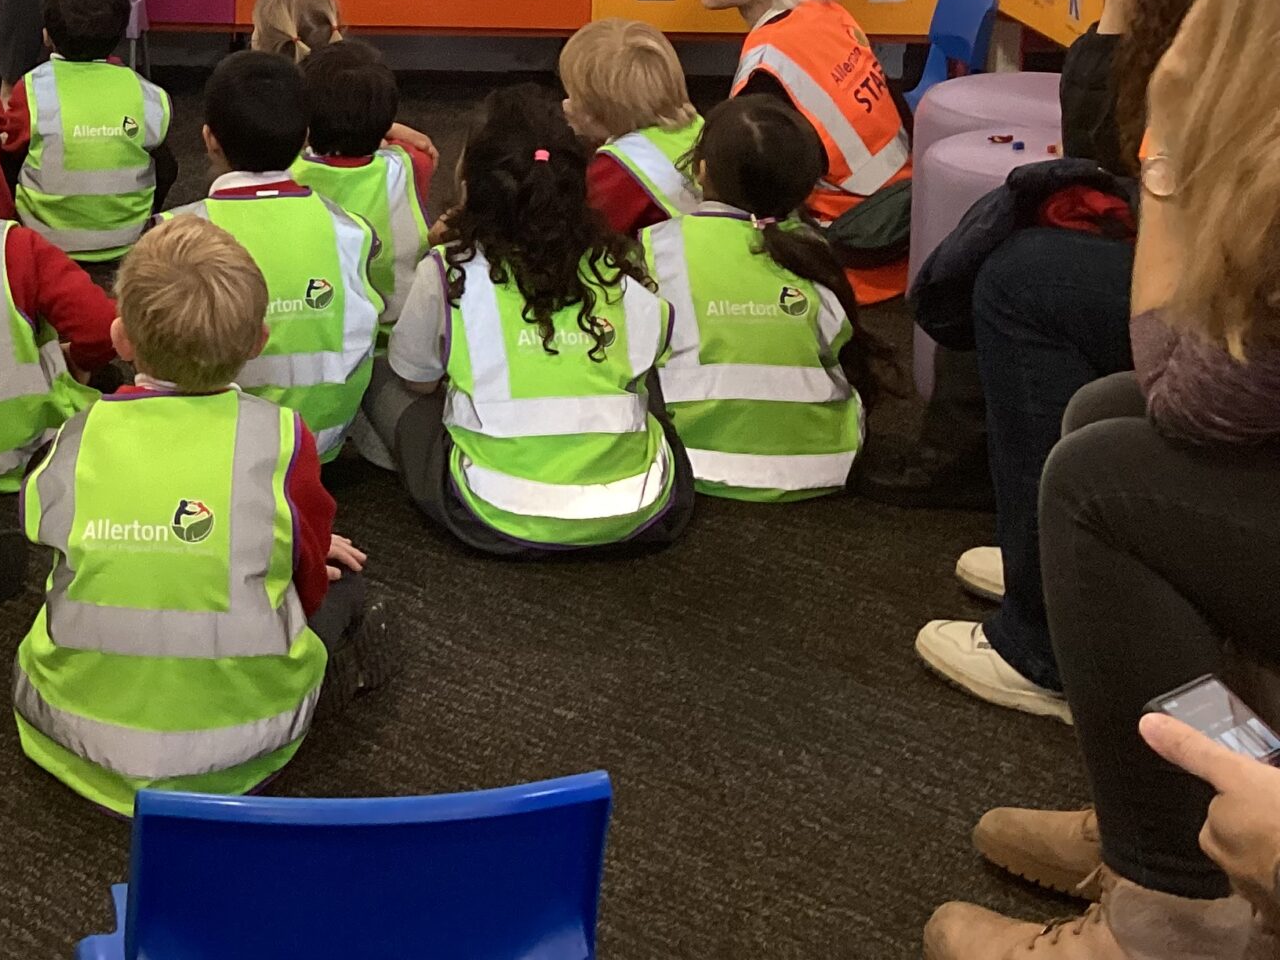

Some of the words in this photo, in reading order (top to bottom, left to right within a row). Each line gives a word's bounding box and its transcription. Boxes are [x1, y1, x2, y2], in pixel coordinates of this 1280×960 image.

[73, 125, 122, 138] Allerton
[268, 298, 303, 314] rton
[706, 300, 777, 317] Allerton
[82, 518, 169, 541] Allerton
